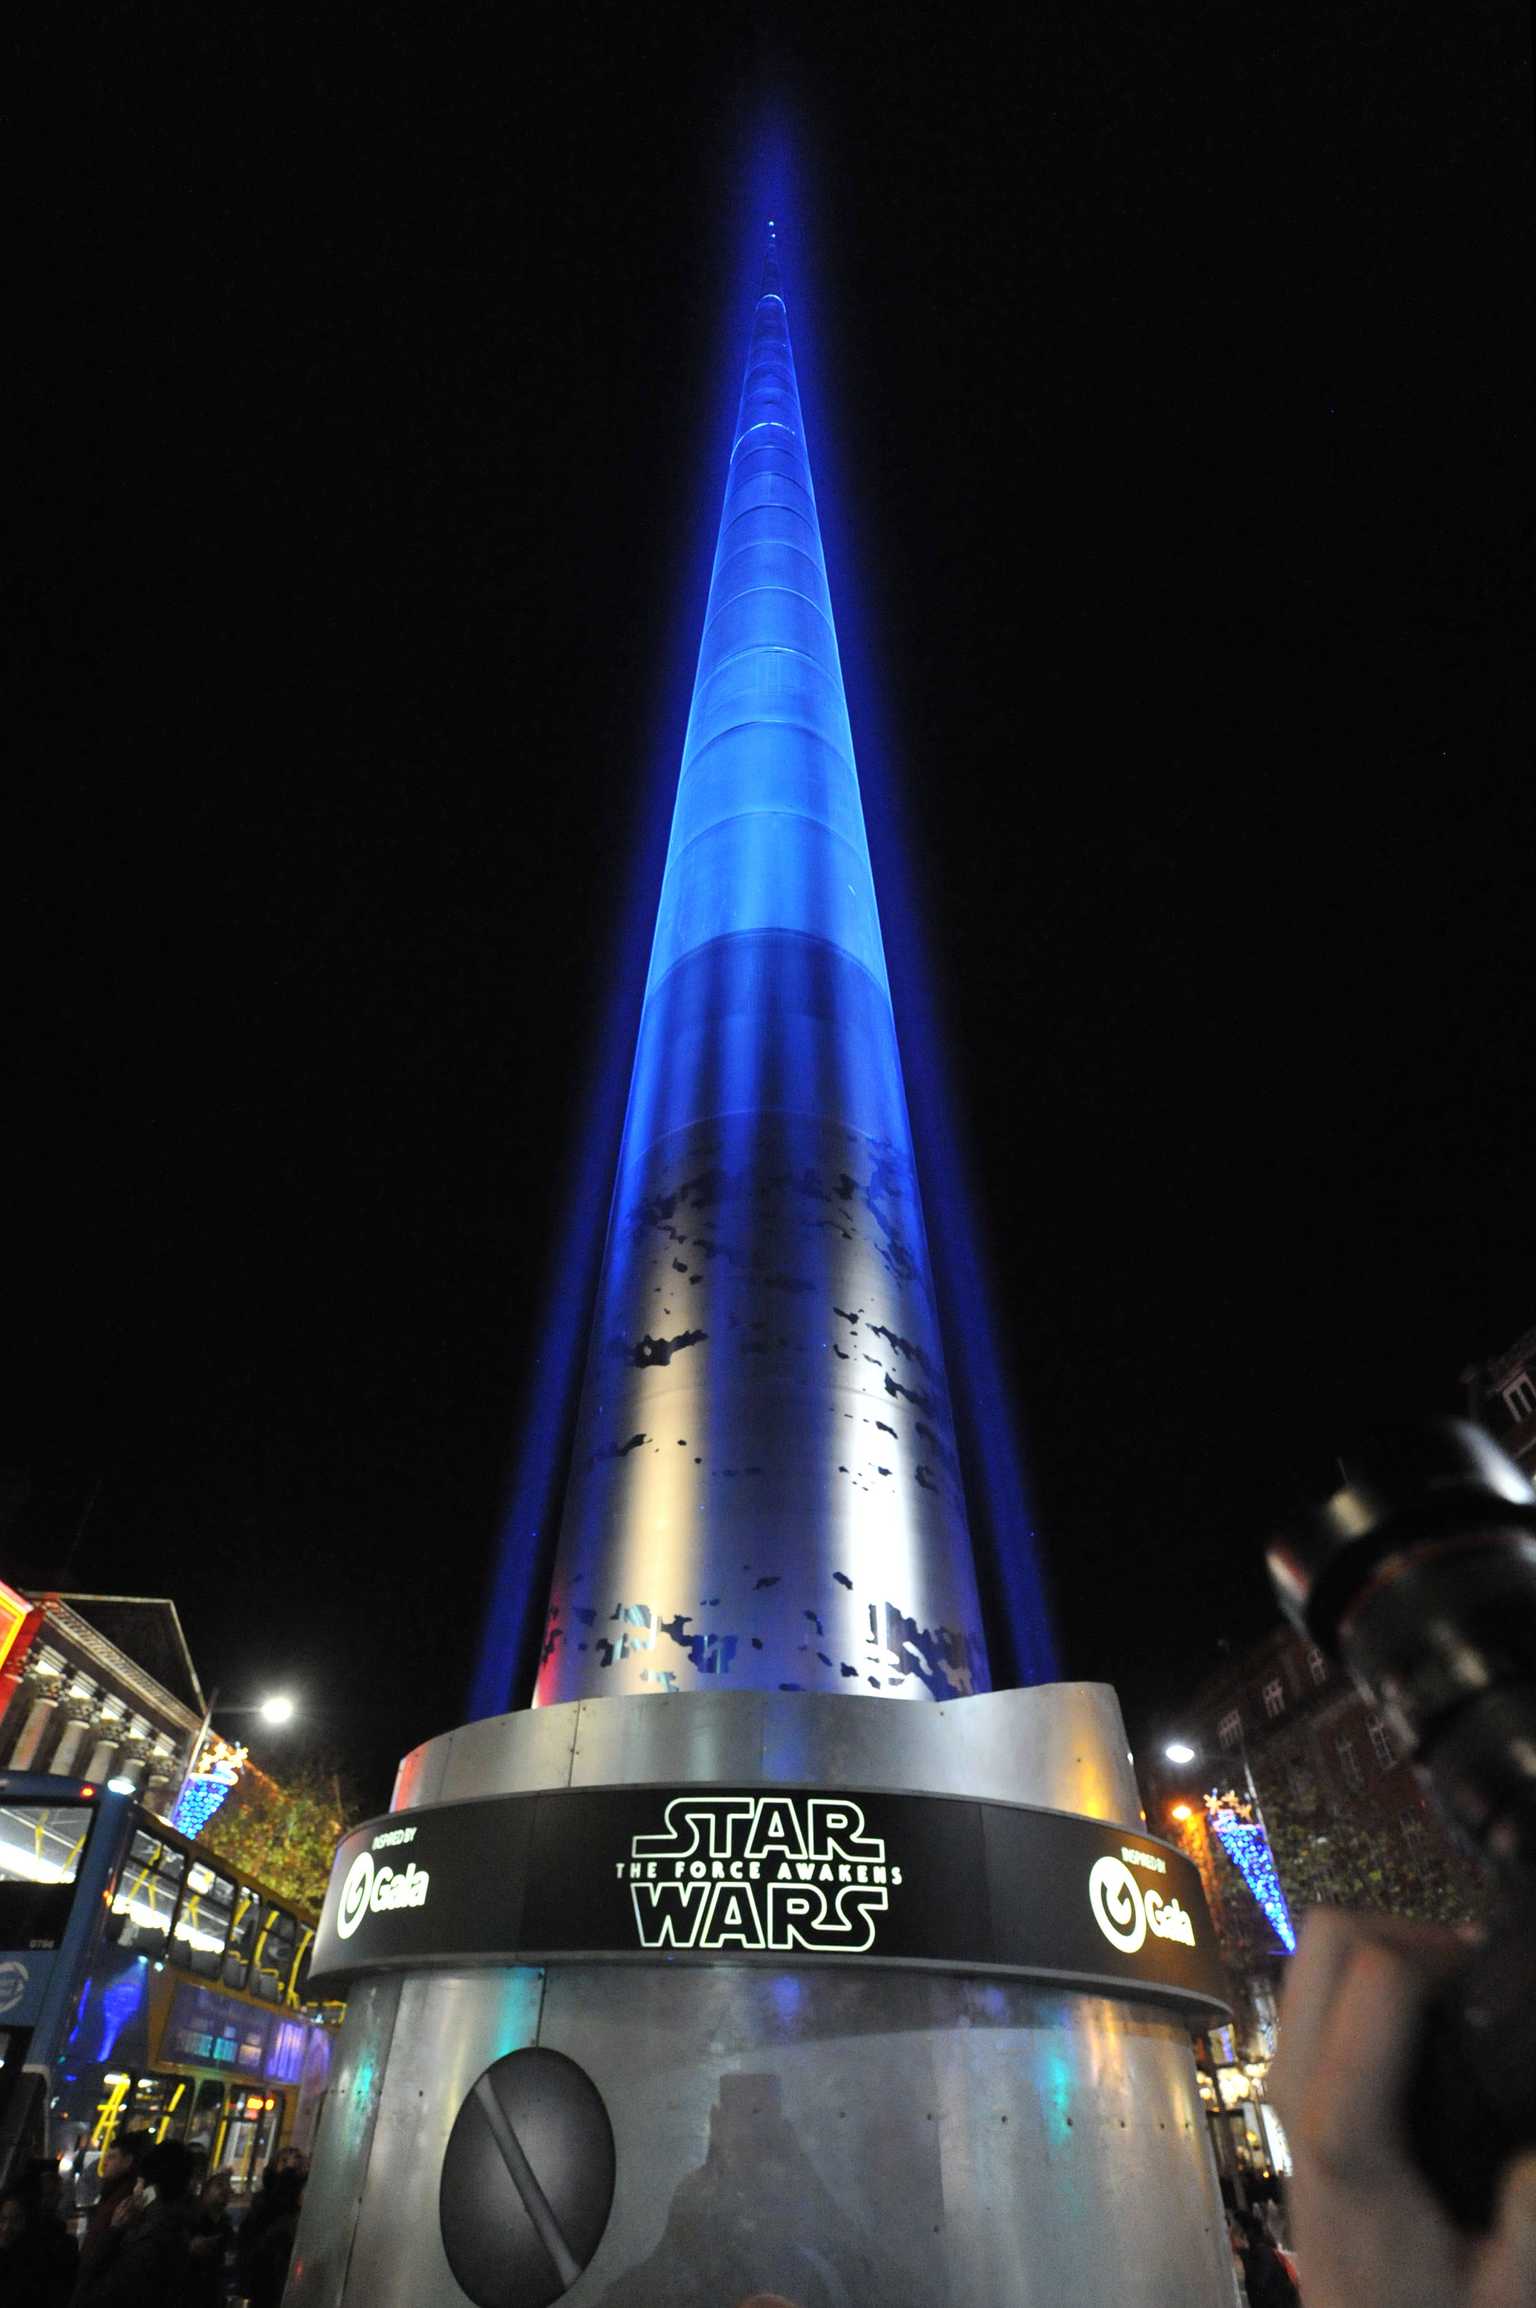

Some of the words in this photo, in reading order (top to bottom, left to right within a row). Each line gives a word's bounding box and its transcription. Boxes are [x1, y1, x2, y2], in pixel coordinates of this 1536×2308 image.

[631, 1797, 886, 1863] STAR
[369, 1862, 430, 1913] Gala
[615, 1862, 657, 1879] THE
[675, 1861, 761, 1879] FORCE
[777, 1862, 903, 1885] AWAKENS
[630, 1881, 889, 1952] WARS
[1143, 1889, 1197, 1947] Gala
